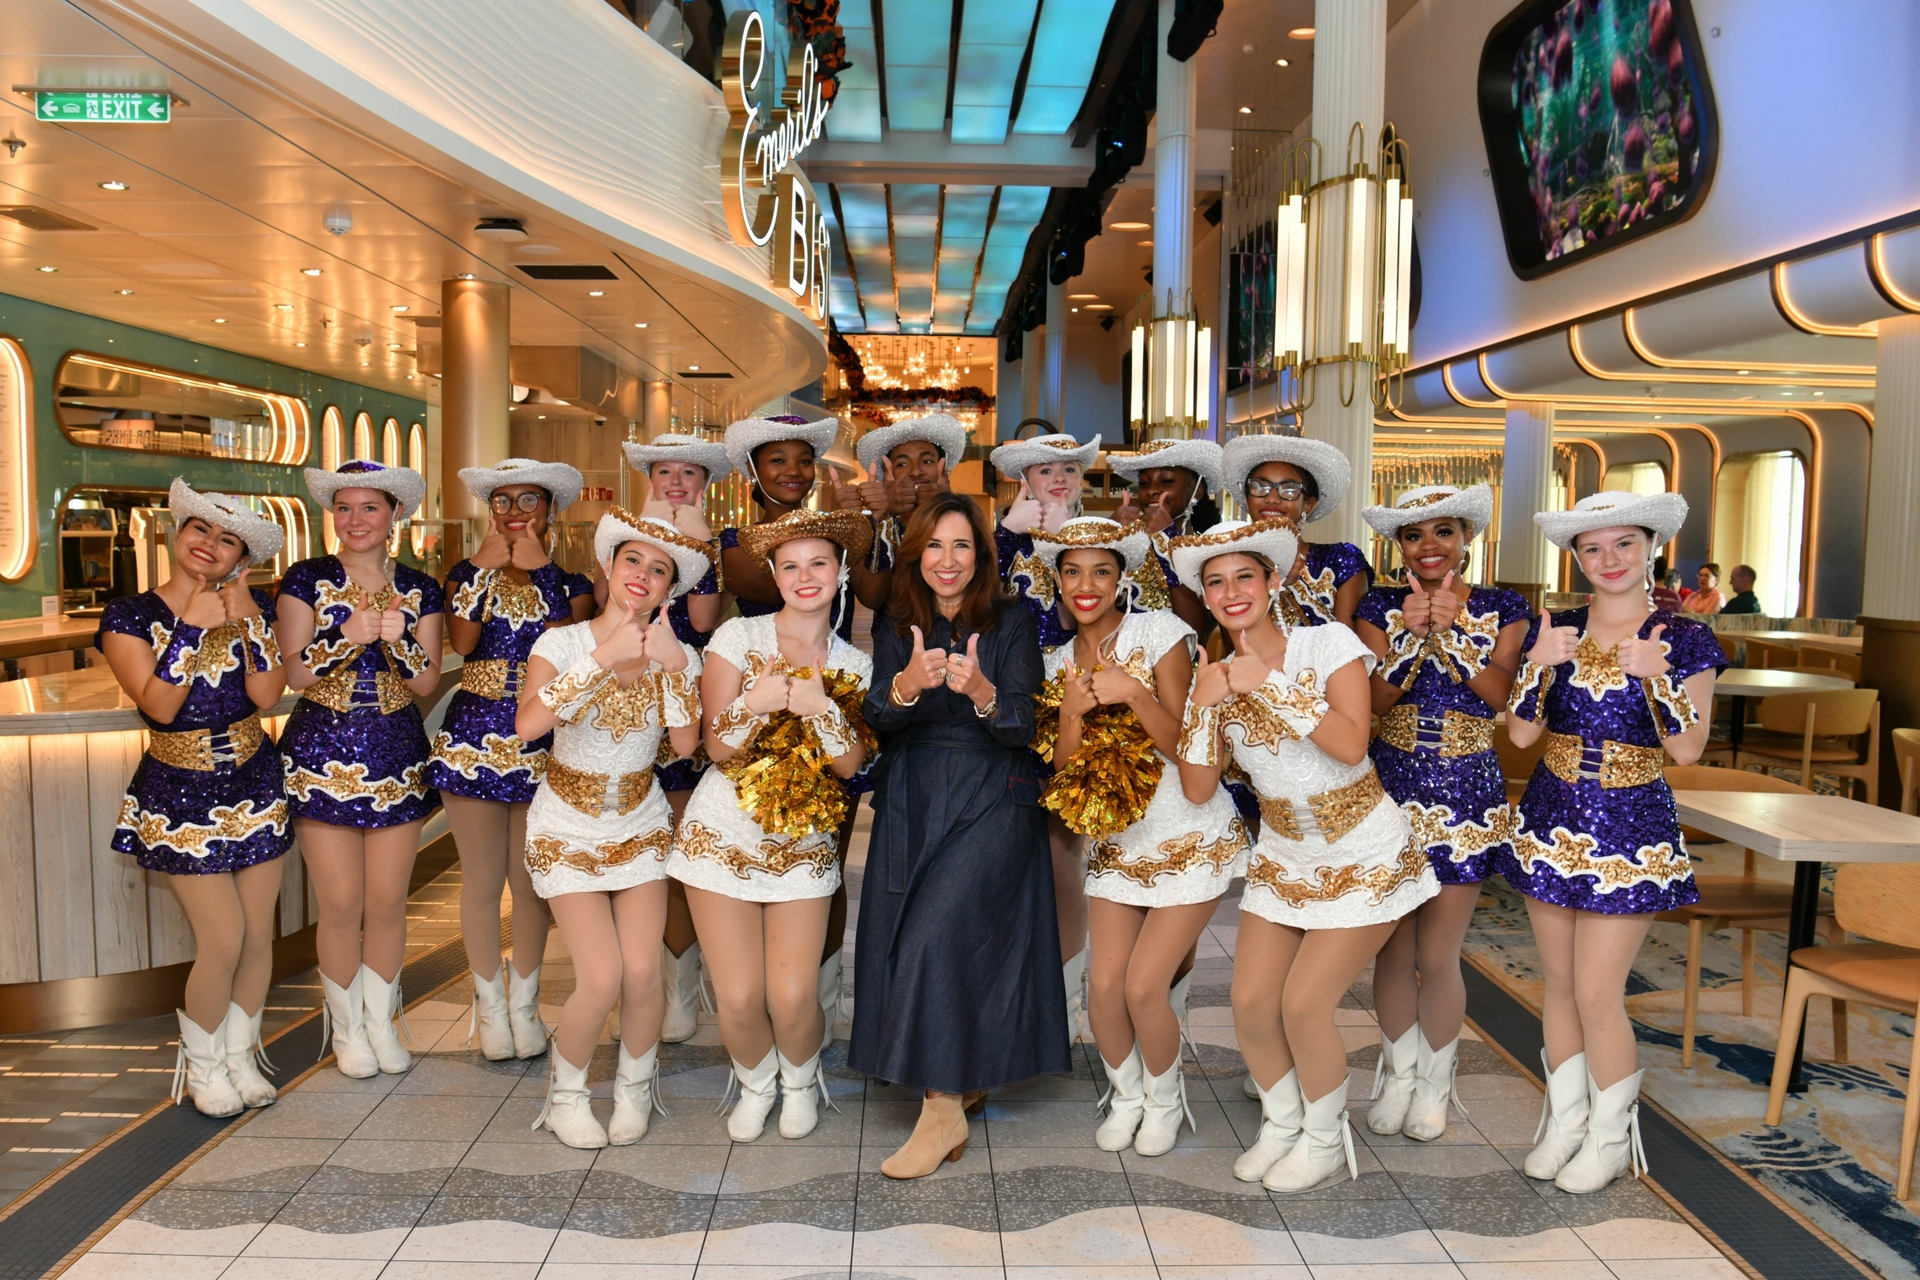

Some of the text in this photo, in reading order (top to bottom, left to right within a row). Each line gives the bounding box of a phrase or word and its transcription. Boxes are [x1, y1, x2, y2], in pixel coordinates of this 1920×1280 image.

[102, 100, 142, 119] EXIT
[740, 11, 829, 247] Emeril's
[789, 176, 830, 325] BIS
